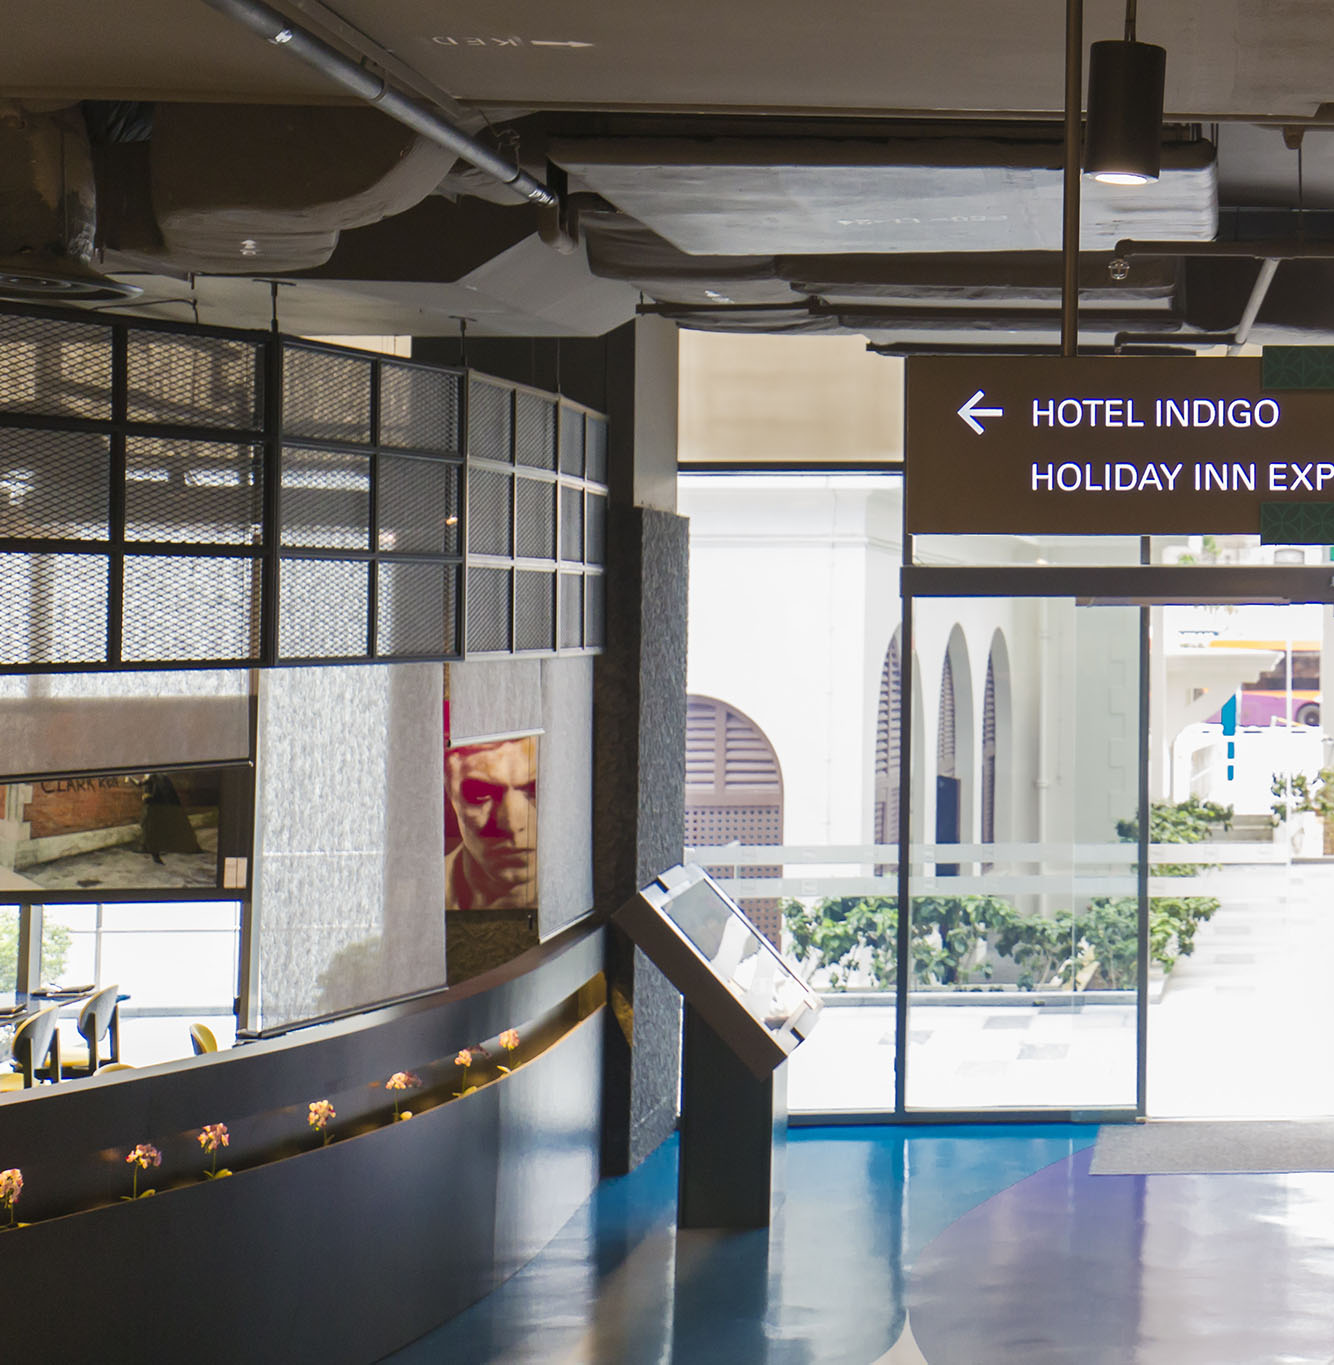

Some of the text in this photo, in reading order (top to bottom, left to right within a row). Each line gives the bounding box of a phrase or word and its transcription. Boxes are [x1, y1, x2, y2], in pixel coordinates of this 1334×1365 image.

[1032, 400, 1279, 428] HOTEL INDIGO
[1031, 463, 1183, 492] HOLIDAY
[1194, 463, 1255, 492] INN
